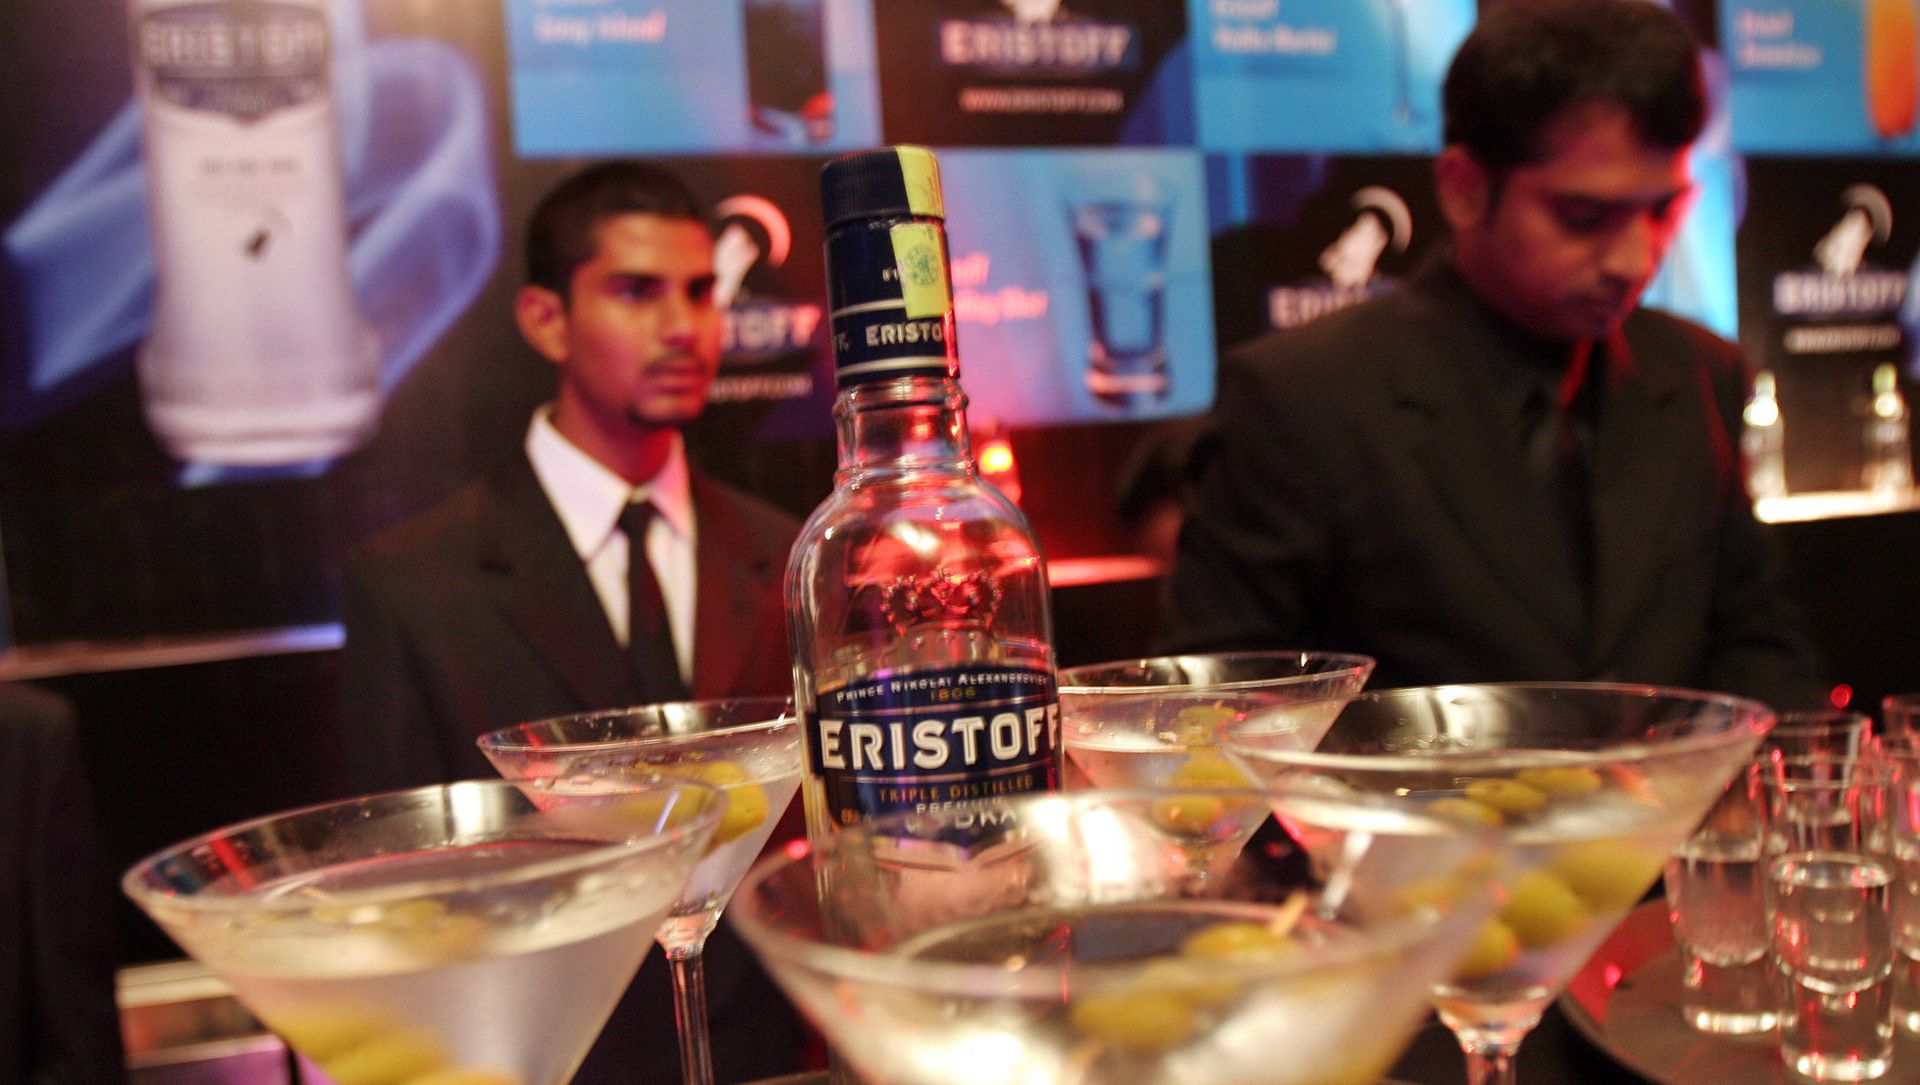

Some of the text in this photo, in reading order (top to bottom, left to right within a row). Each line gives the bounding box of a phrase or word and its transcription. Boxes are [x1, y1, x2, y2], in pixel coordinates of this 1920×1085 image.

[940, 20, 1131, 65] ERISTOFF
[720, 303, 821, 351] TOFF
[865, 321, 946, 345] ERISTO
[836, 684, 885, 704] PRINCE
[890, 676, 951, 694] NIKOLAI
[818, 702, 1060, 771] ERISTOFF
[879, 773, 1034, 802] TRIPLE DISTILLED
[915, 796, 1003, 817] PREM
[905, 808, 1018, 834] VDKA
